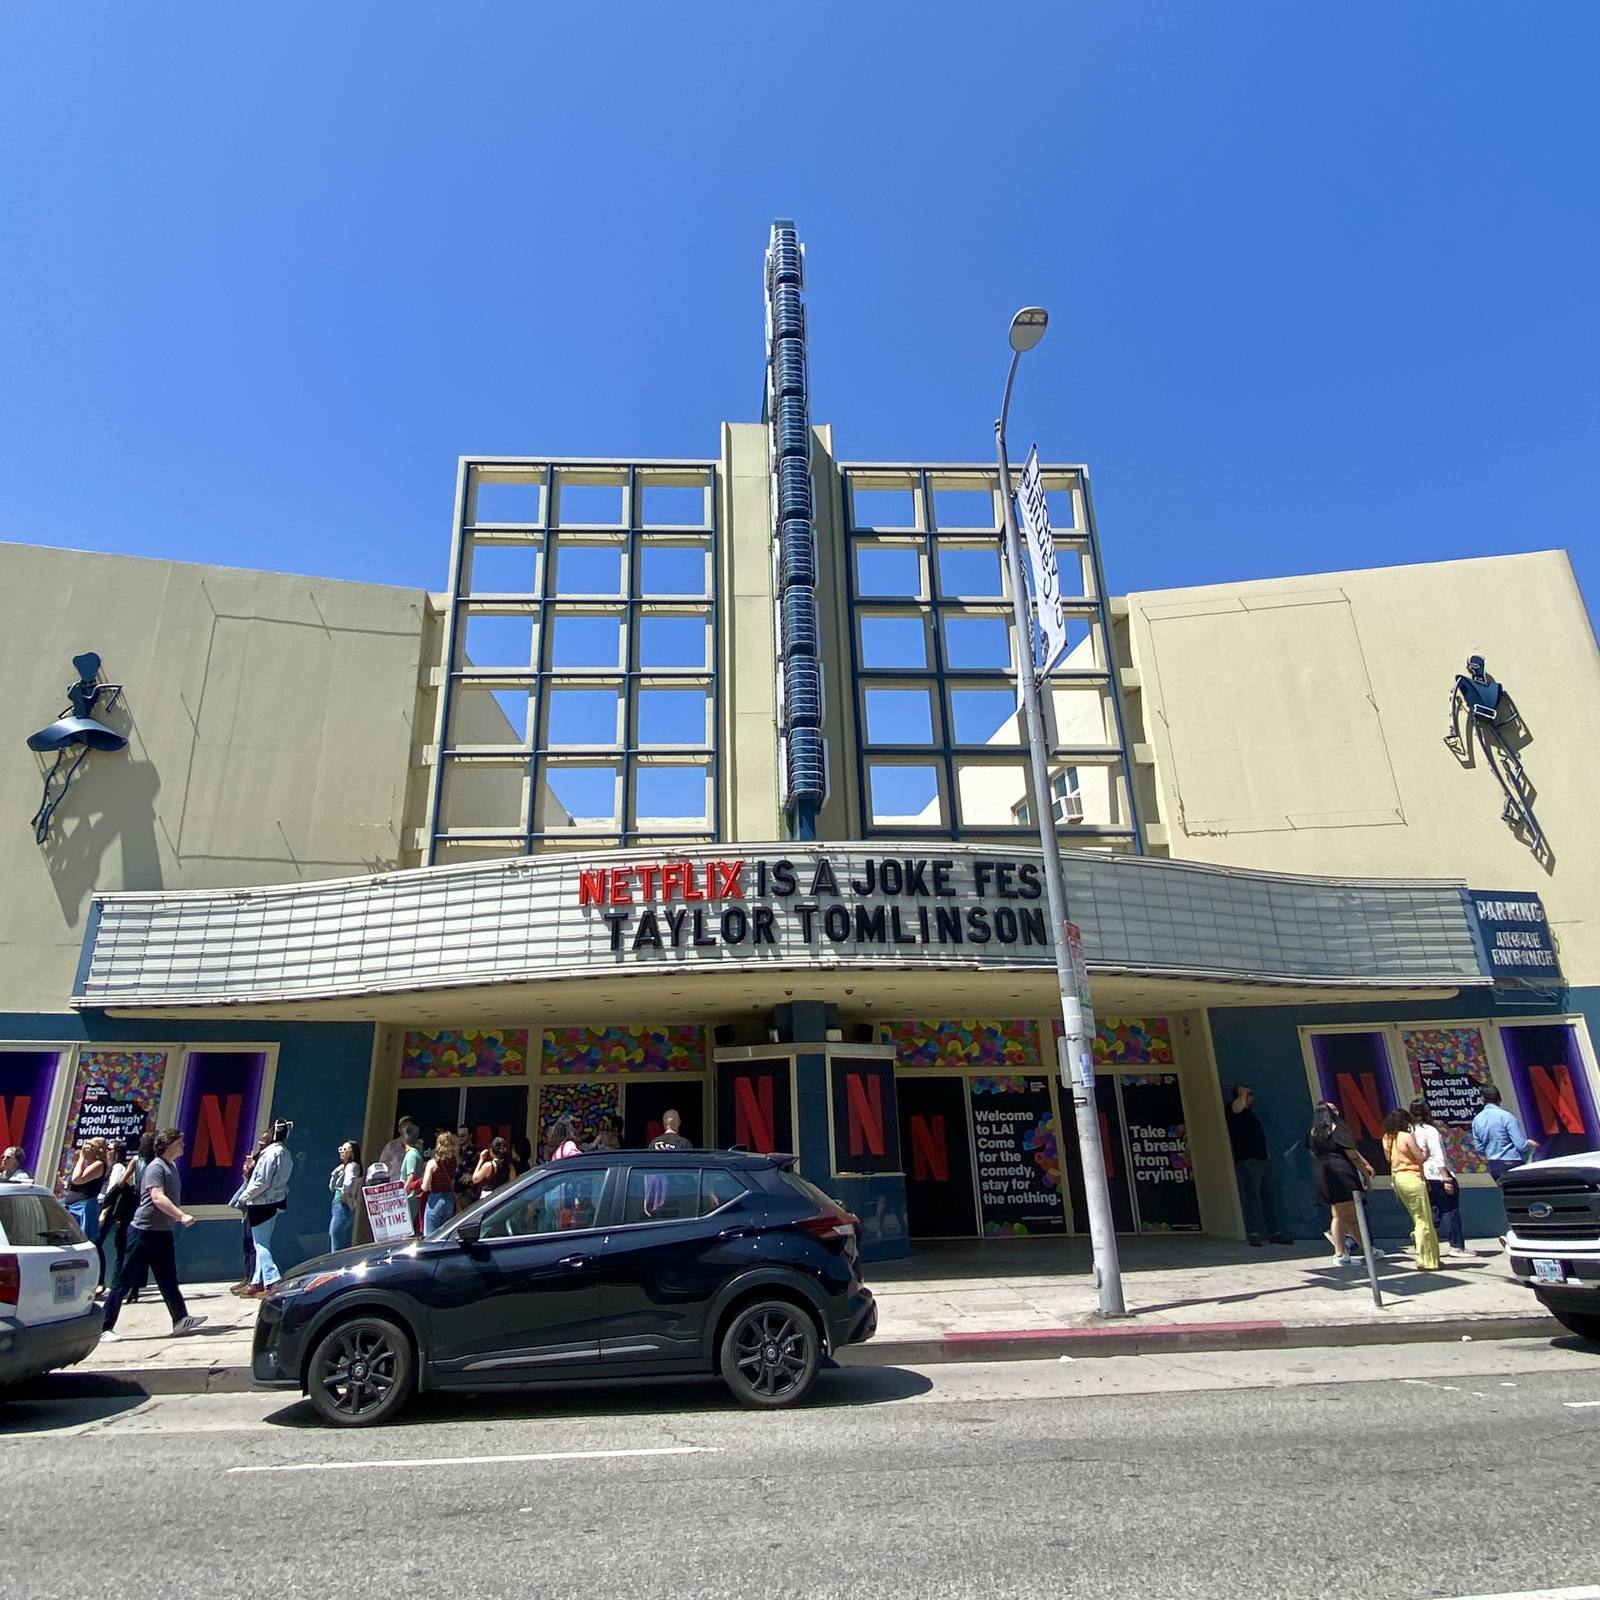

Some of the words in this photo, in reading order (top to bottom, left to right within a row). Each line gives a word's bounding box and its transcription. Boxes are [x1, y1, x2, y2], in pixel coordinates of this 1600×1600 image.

[578, 860, 745, 906] NETFLIX
[757, 860, 796, 897] IS
[810, 859, 839, 896] A
[852, 859, 956, 896] JOKE
[974, 861, 1063, 899] FES
[1475, 900, 1544, 922] PARKING
[604, 906, 775, 950] TAYLOR
[794, 905, 1047, 945] TOMLINSON
[1492, 949, 1555, 966] ENTRANCE
[1423, 1078, 1444, 1087] You
[1445, 1077, 1469, 1086] can't
[1426, 1087, 1449, 1098] spell
[1450, 1086, 1481, 1097] 'laugh'
[1337, 1073, 1384, 1139] N
[1428, 1098, 1466, 1107] without
[1466, 1097, 1485, 1105] 'LA'
[1528, 1066, 1585, 1134] N
[84, 1104, 105, 1113] You
[106, 1103, 133, 1112] can't
[735, 1075, 774, 1154] N
[847, 1073, 884, 1155] N
[1430, 1108, 1449, 1117] and
[1450, 1107, 1476, 1118] 'ugh'.
[81, 1115, 107, 1126] spell
[108, 1114, 144, 1125] 'laugh'
[975, 1110, 1034, 1121] Welcome
[79, 1126, 120, 1135] without
[122, 1126, 143, 1135] 'LA'
[192, 1095, 241, 1167] N
[976, 1124, 990, 1135] to
[992, 1123, 1014, 1135] LA!
[1129, 1125, 1166, 1138] Take
[911, 1115, 949, 1181] N
[978, 1138, 1015, 1149] Come
[1132, 1142, 1141, 1152] a
[1144, 1138, 1186, 1152] break
[979, 1151, 998, 1162] for
[1000, 1150, 1021, 1162] the
[1134, 1153, 1169, 1166] from
[980, 1164, 1035, 1178] comedy,
[1136, 1166, 1188, 1184] crying!
[982, 1179, 1009, 1193] stay
[1011, 1178, 1030, 1189] for
[983, 1192, 1005, 1204] the
[1007, 1191, 1061, 1205] nothing.
[368, 1201, 381, 1215] NO
[380, 1198, 407, 1214] STOPPING
